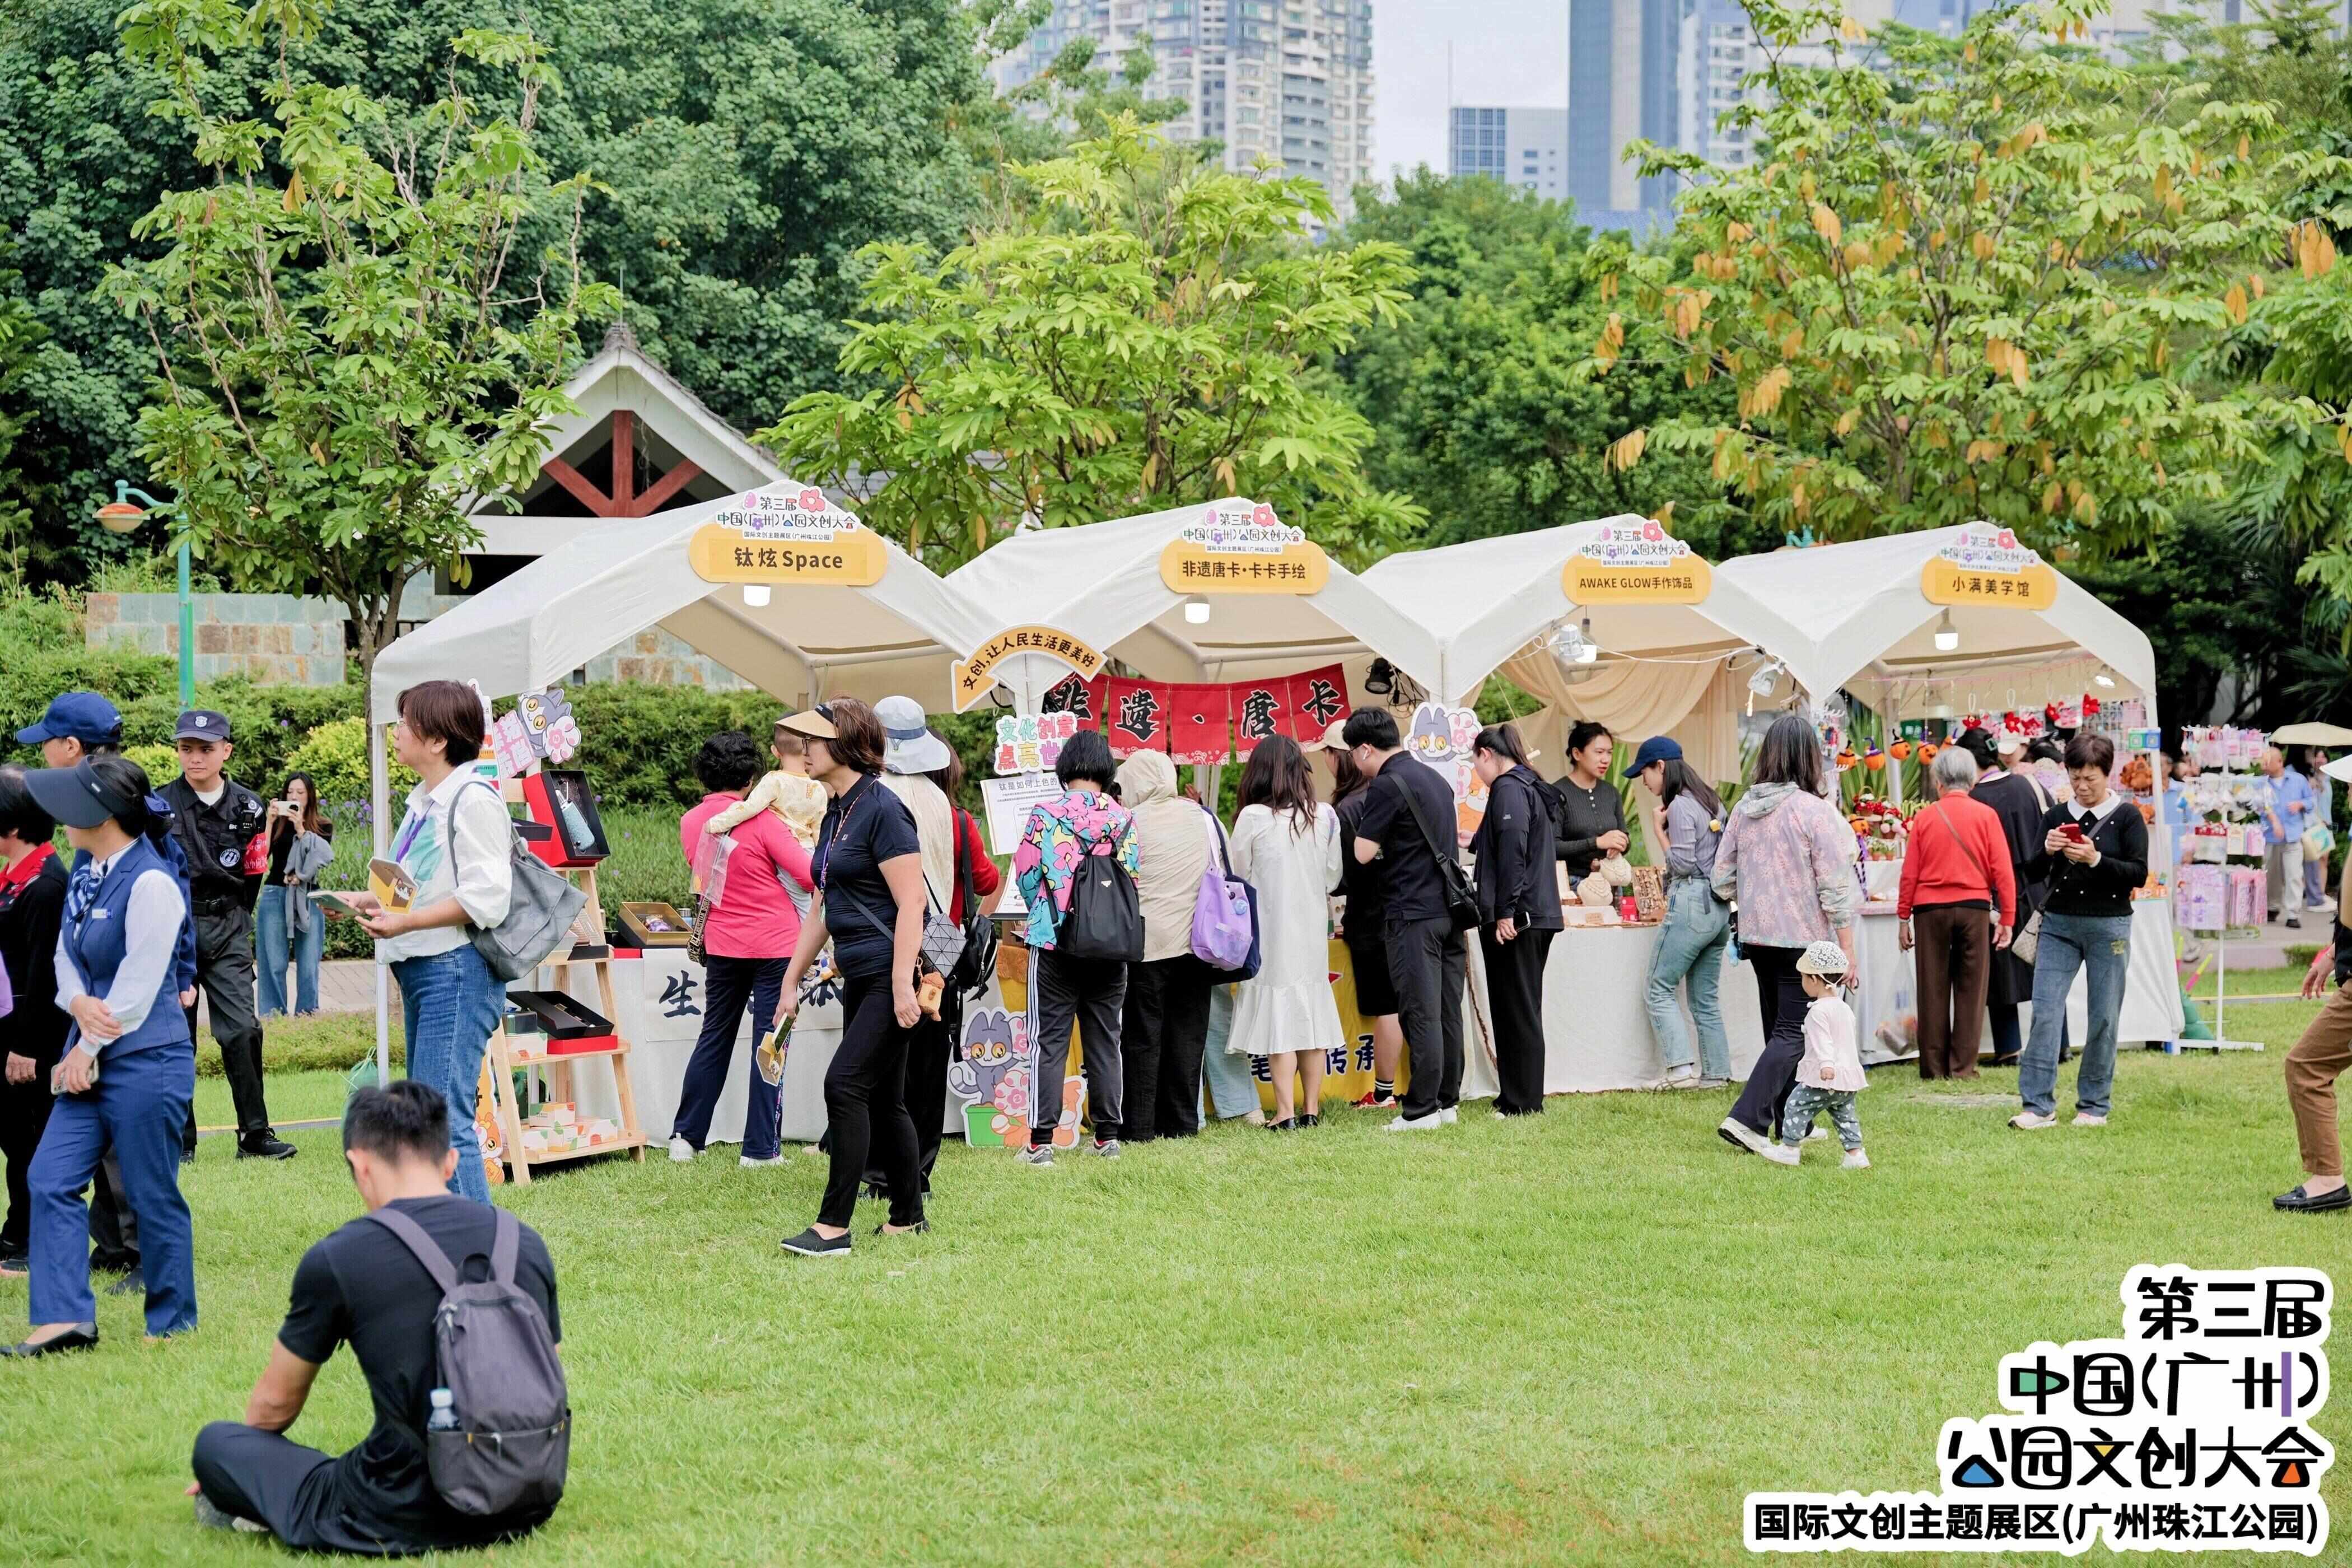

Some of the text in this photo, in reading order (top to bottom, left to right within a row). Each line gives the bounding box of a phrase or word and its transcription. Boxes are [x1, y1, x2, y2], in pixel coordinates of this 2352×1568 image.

[760, 496, 797, 511] 第三届
[1220, 513, 1252, 526] 第三届
[1613, 529, 1641, 542] 第三届
[735, 547, 843, 572] 钛炫Space
[1580, 578, 1617, 588] AWAKE
[1953, 577, 2029, 597] 小满美学馆
[999, 715, 1074, 743] 文化创意
